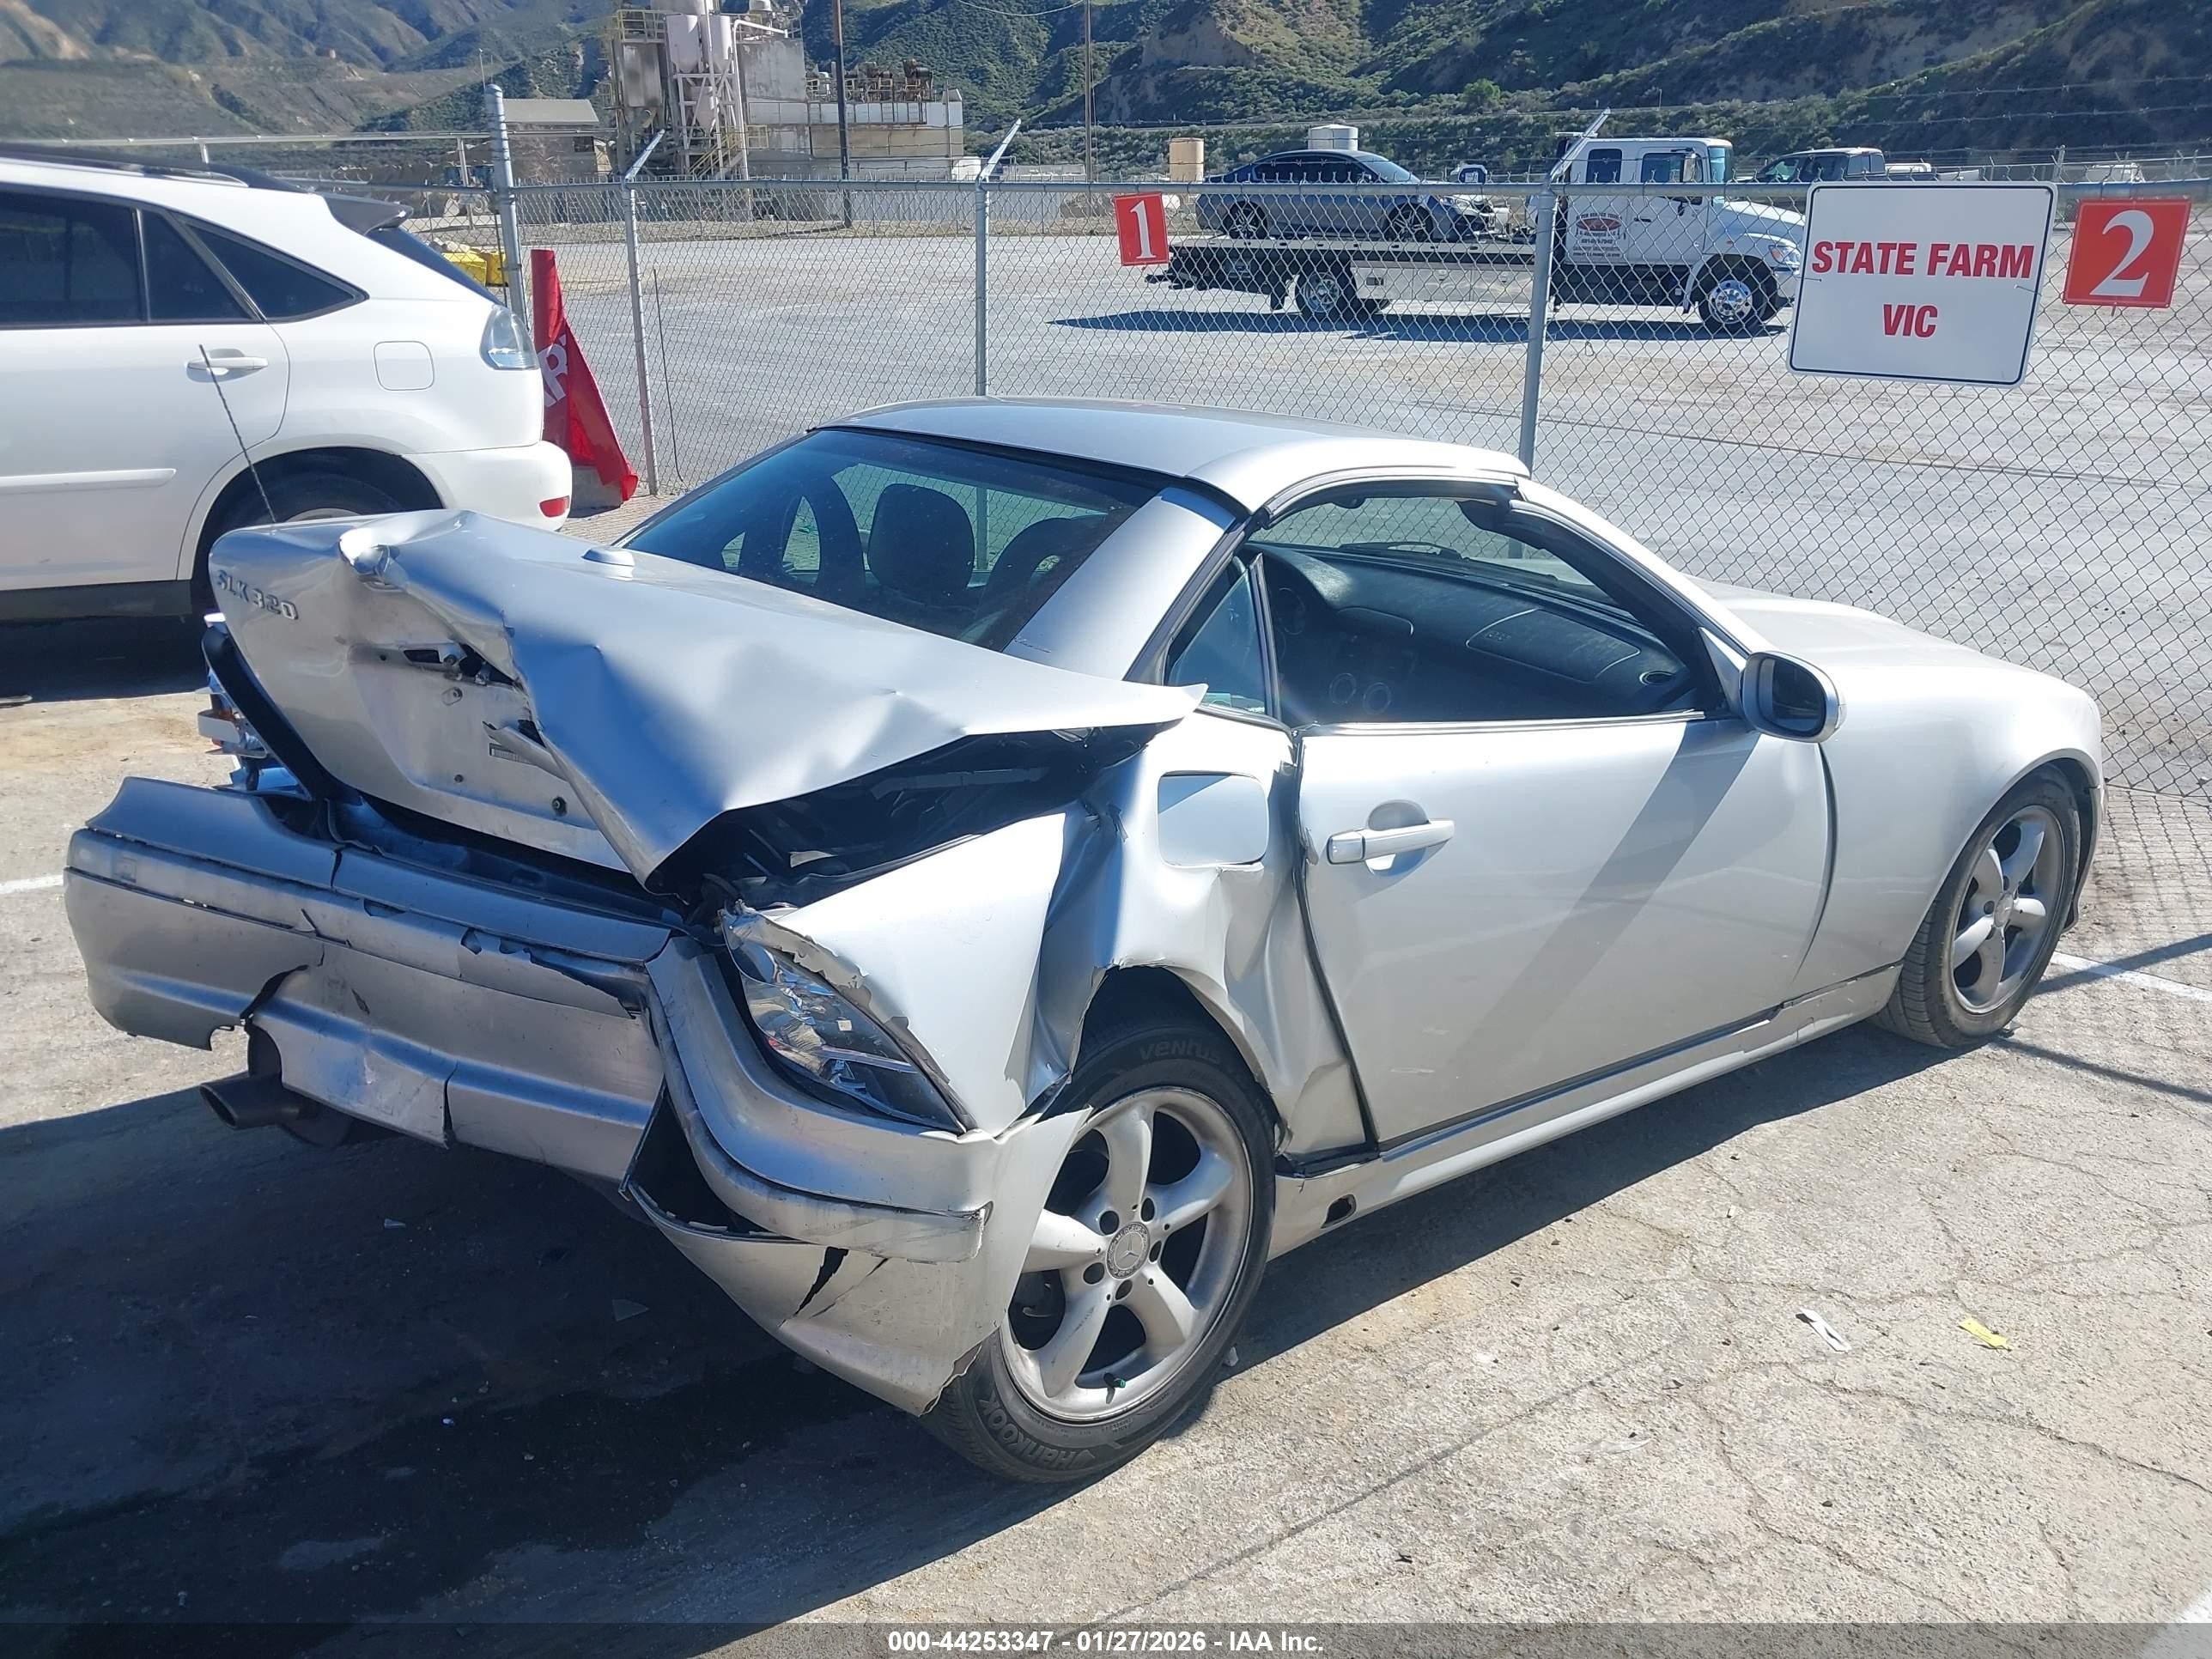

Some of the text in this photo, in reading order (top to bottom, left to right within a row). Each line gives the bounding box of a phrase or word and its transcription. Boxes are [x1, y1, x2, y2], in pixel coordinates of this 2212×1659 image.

[1129, 200, 1157, 258] 1
[2088, 210, 2155, 297] 2
[1812, 240, 2035, 279] STATE FARM
[1882, 303, 1938, 338] VIC
[217, 569, 299, 620] SLK 320
